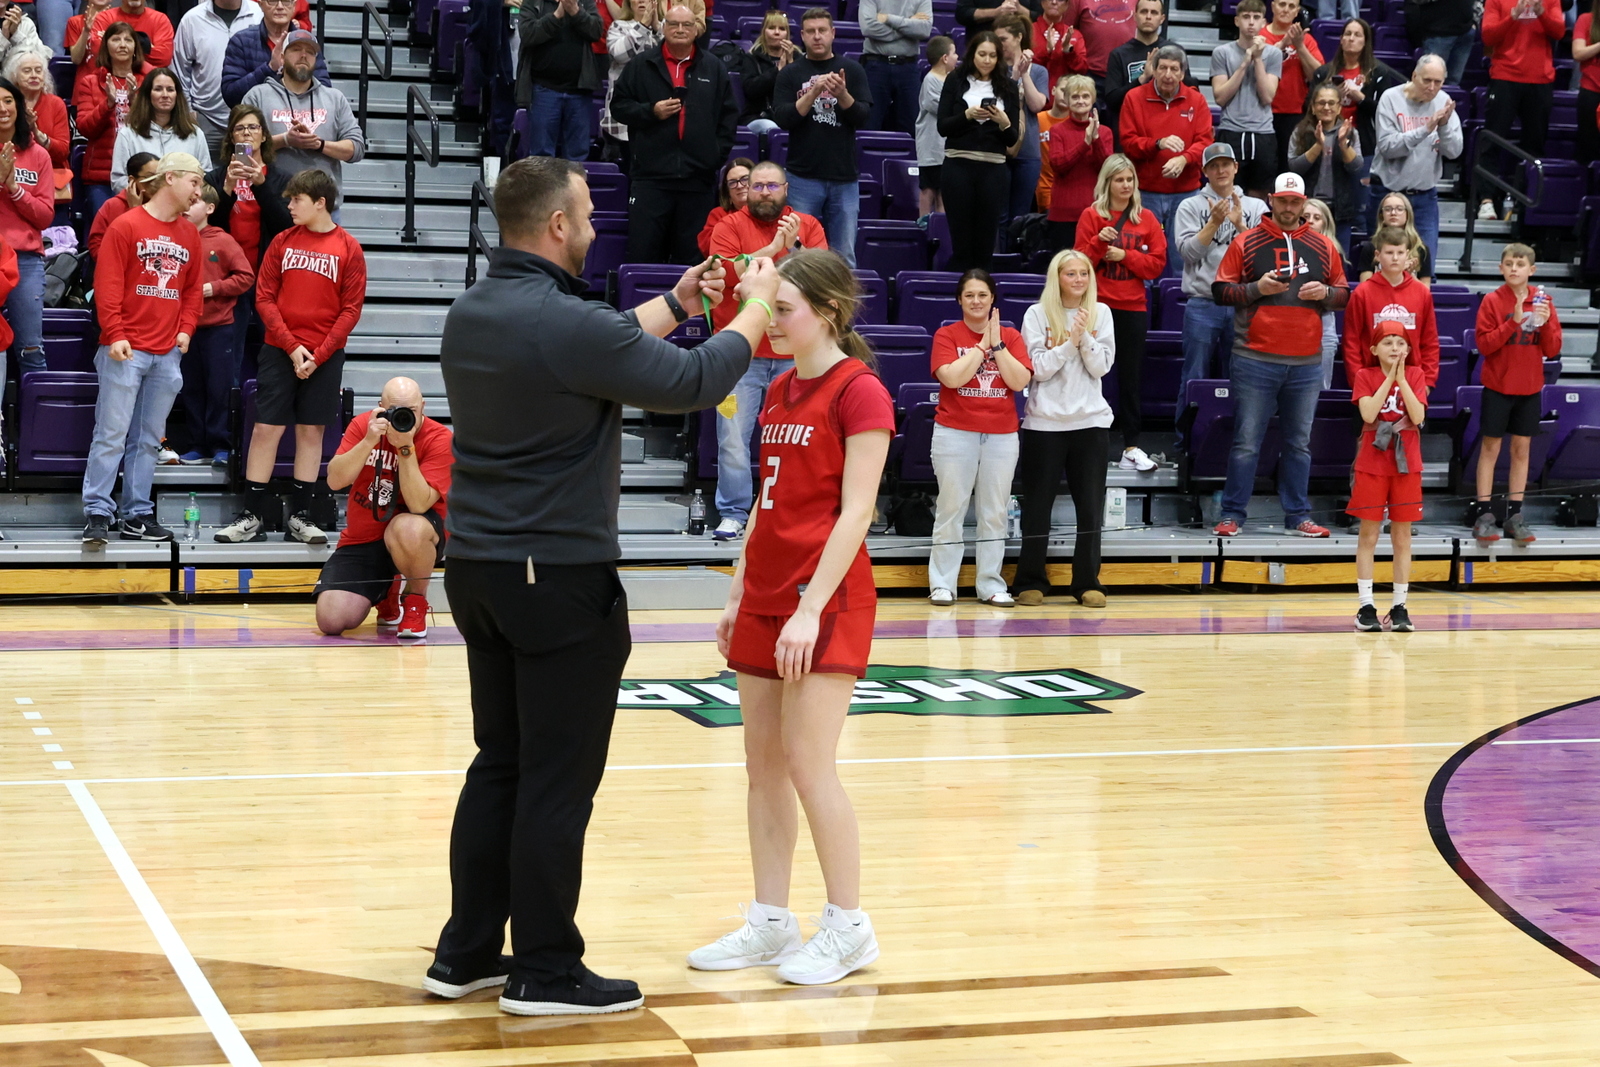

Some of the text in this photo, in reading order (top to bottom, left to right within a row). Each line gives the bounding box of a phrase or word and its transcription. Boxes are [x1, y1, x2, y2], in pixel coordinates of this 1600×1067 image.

[293, 248, 330, 260] BELLEVUE
[281, 247, 340, 284] REDMEN
[688, 327, 698, 335] 34
[956, 387, 985, 398] STATE
[760, 423, 815, 447] ELLEVUE
[760, 455, 781, 510] 2
